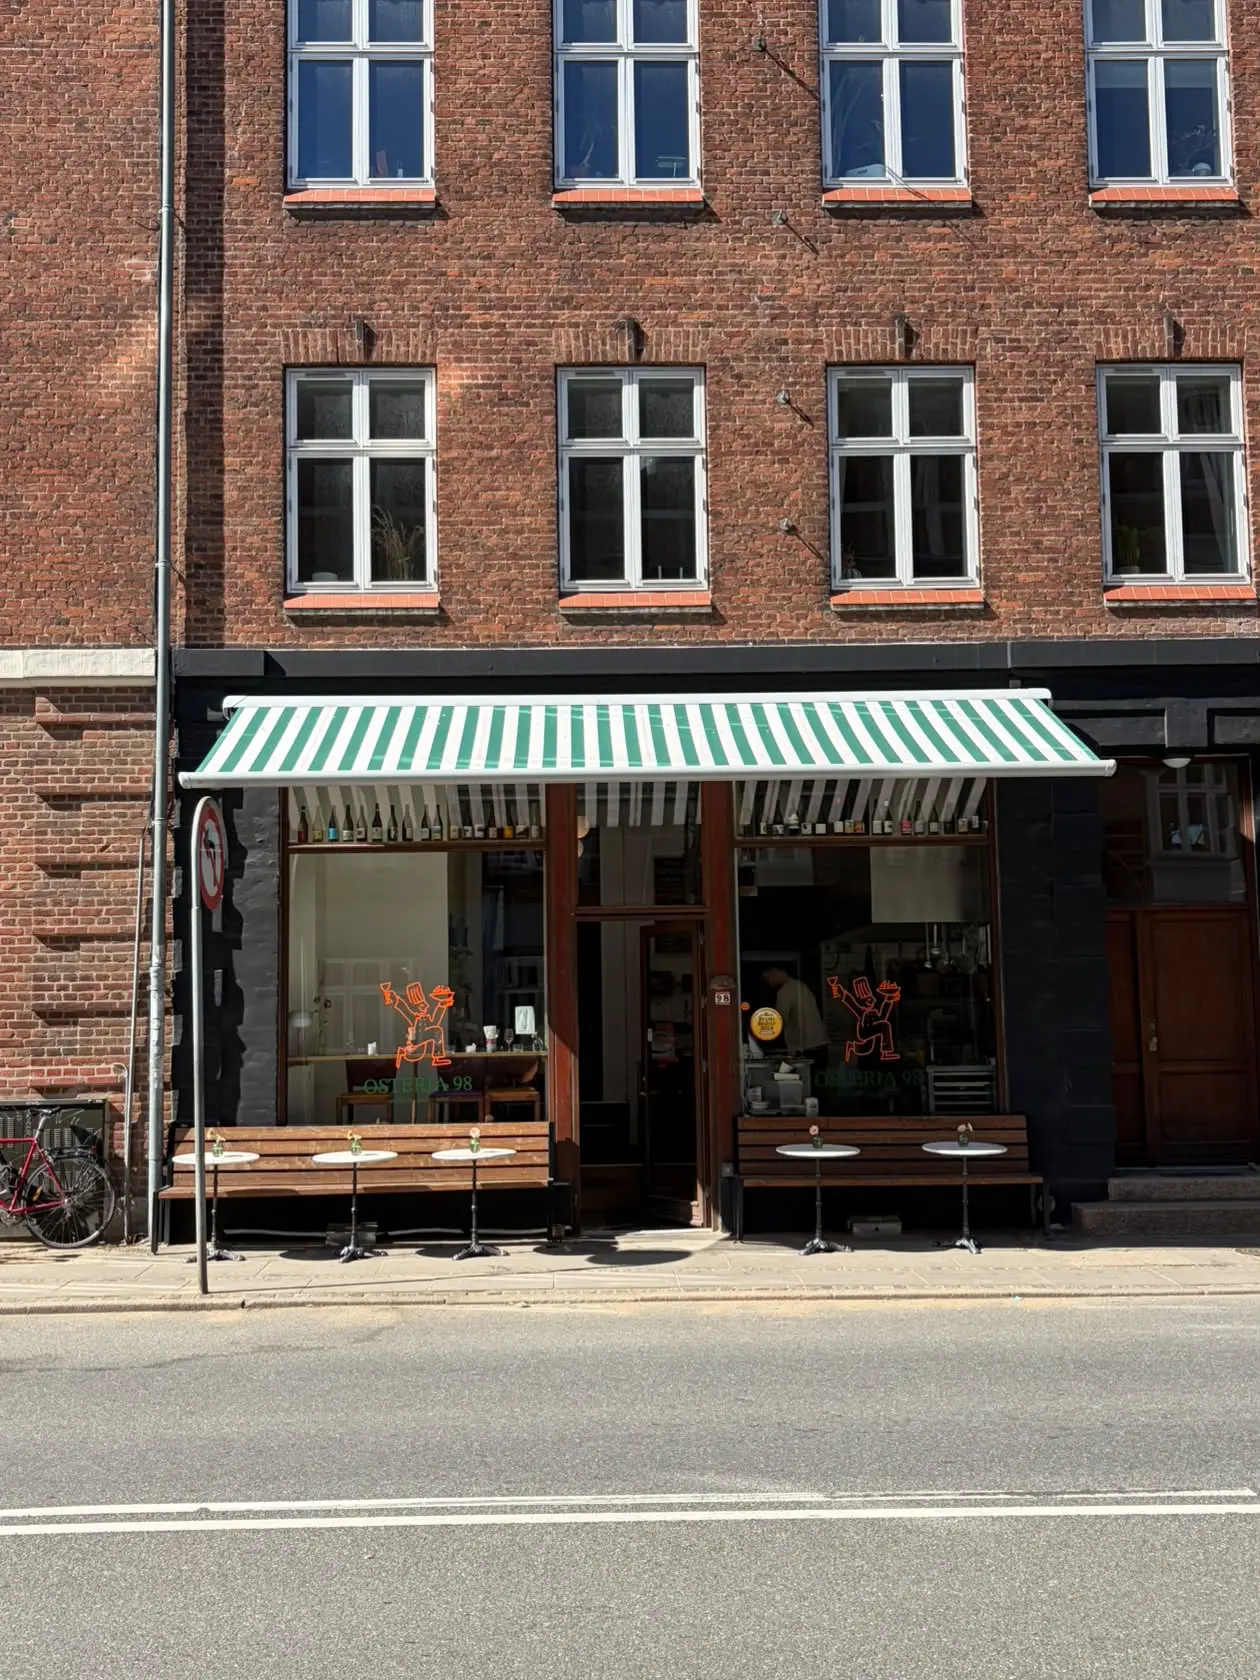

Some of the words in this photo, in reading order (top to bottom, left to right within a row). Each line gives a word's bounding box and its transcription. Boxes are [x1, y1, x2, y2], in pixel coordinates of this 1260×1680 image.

[716, 994, 730, 1002] 98
[363, 1077, 449, 1094] OSTERIA
[453, 1075, 473, 1091] 98
[815, 1070, 896, 1088] OSERIA
[902, 1069, 924, 1087] 98
